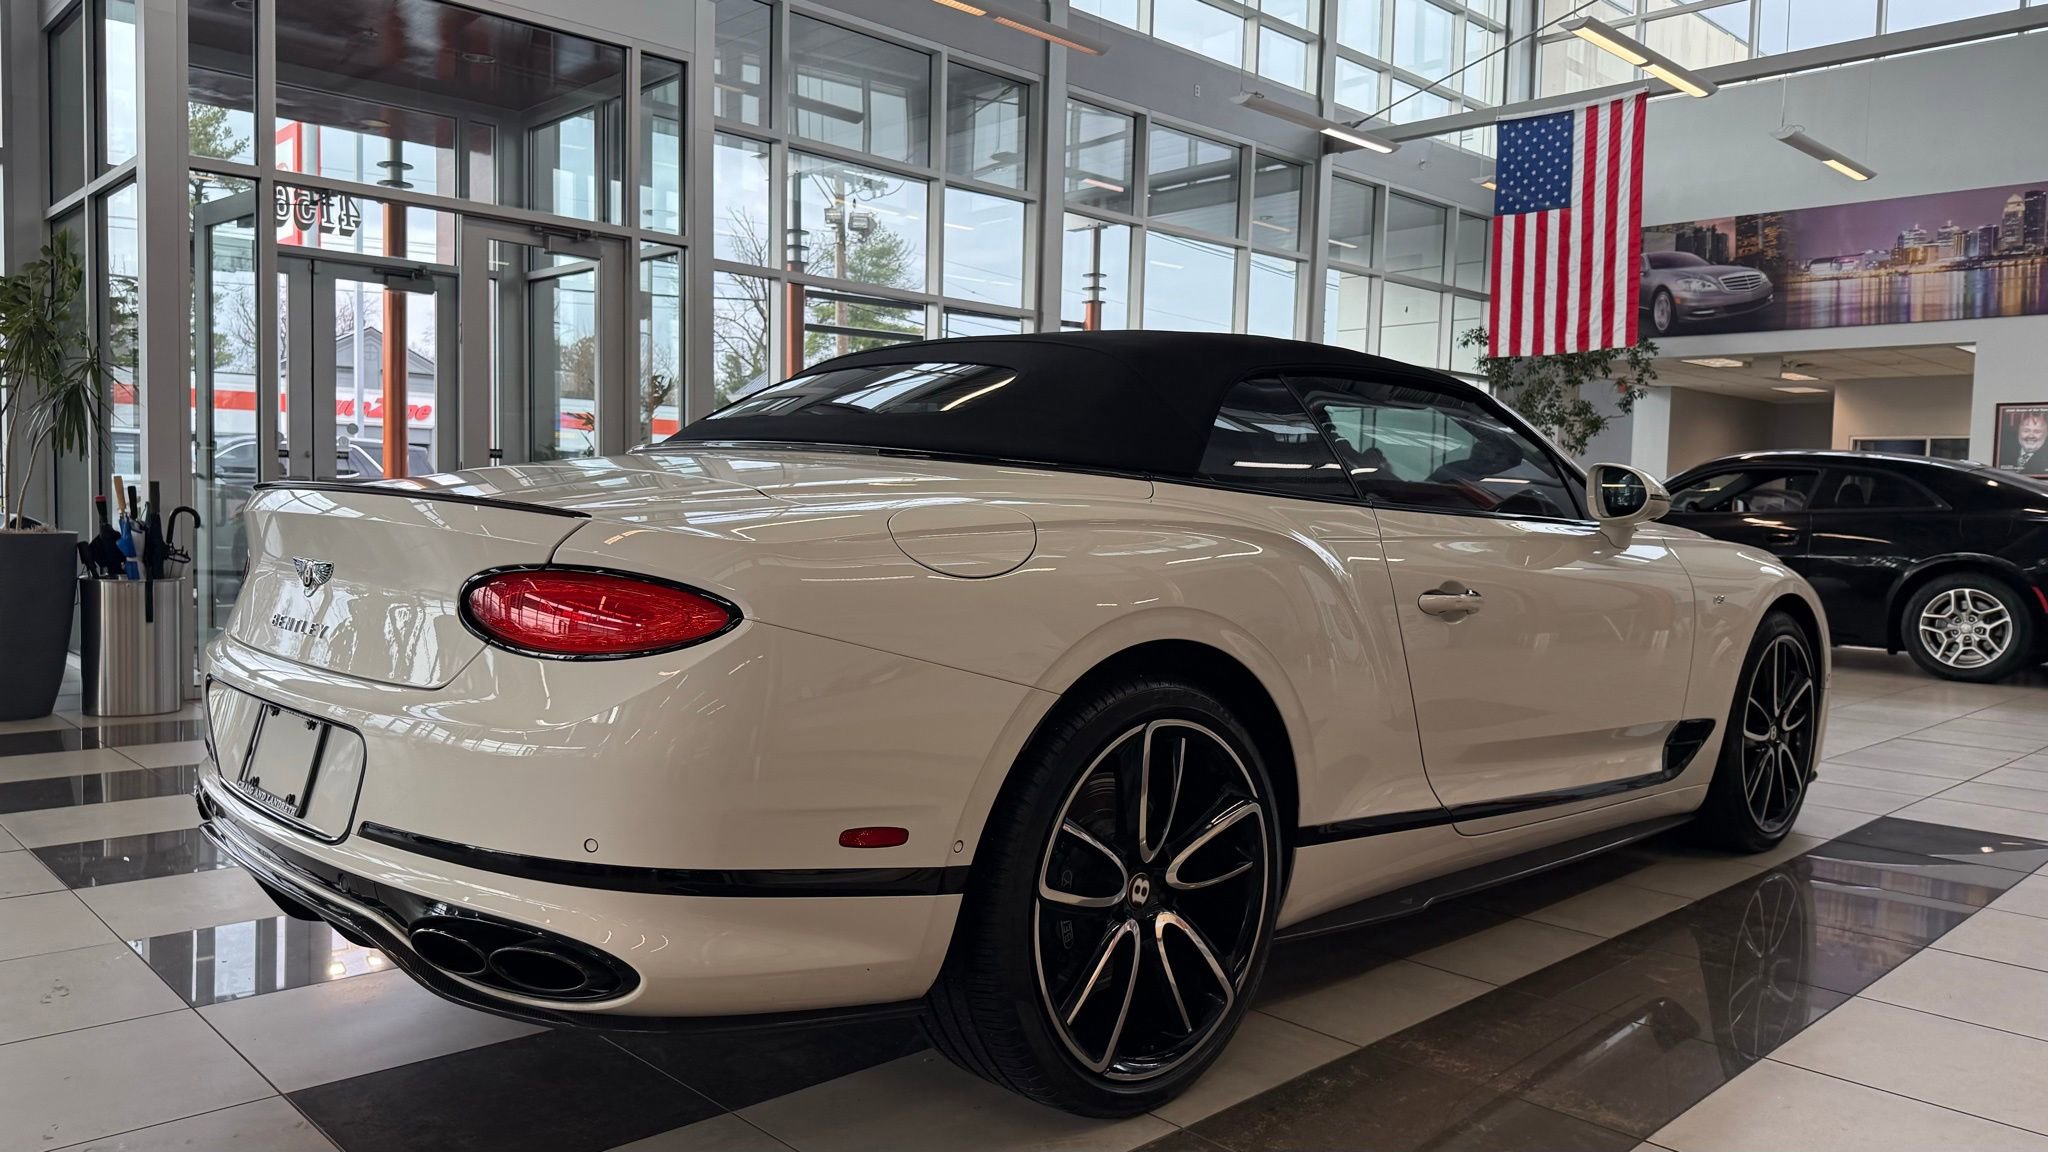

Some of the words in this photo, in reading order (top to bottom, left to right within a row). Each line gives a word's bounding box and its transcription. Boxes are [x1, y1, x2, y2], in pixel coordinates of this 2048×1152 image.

[271, 613, 329, 639] BENTLEY
[253, 789, 266, 800] AND
[265, 794, 297, 816] LANDRETH
[1132, 878, 1150, 904] B
